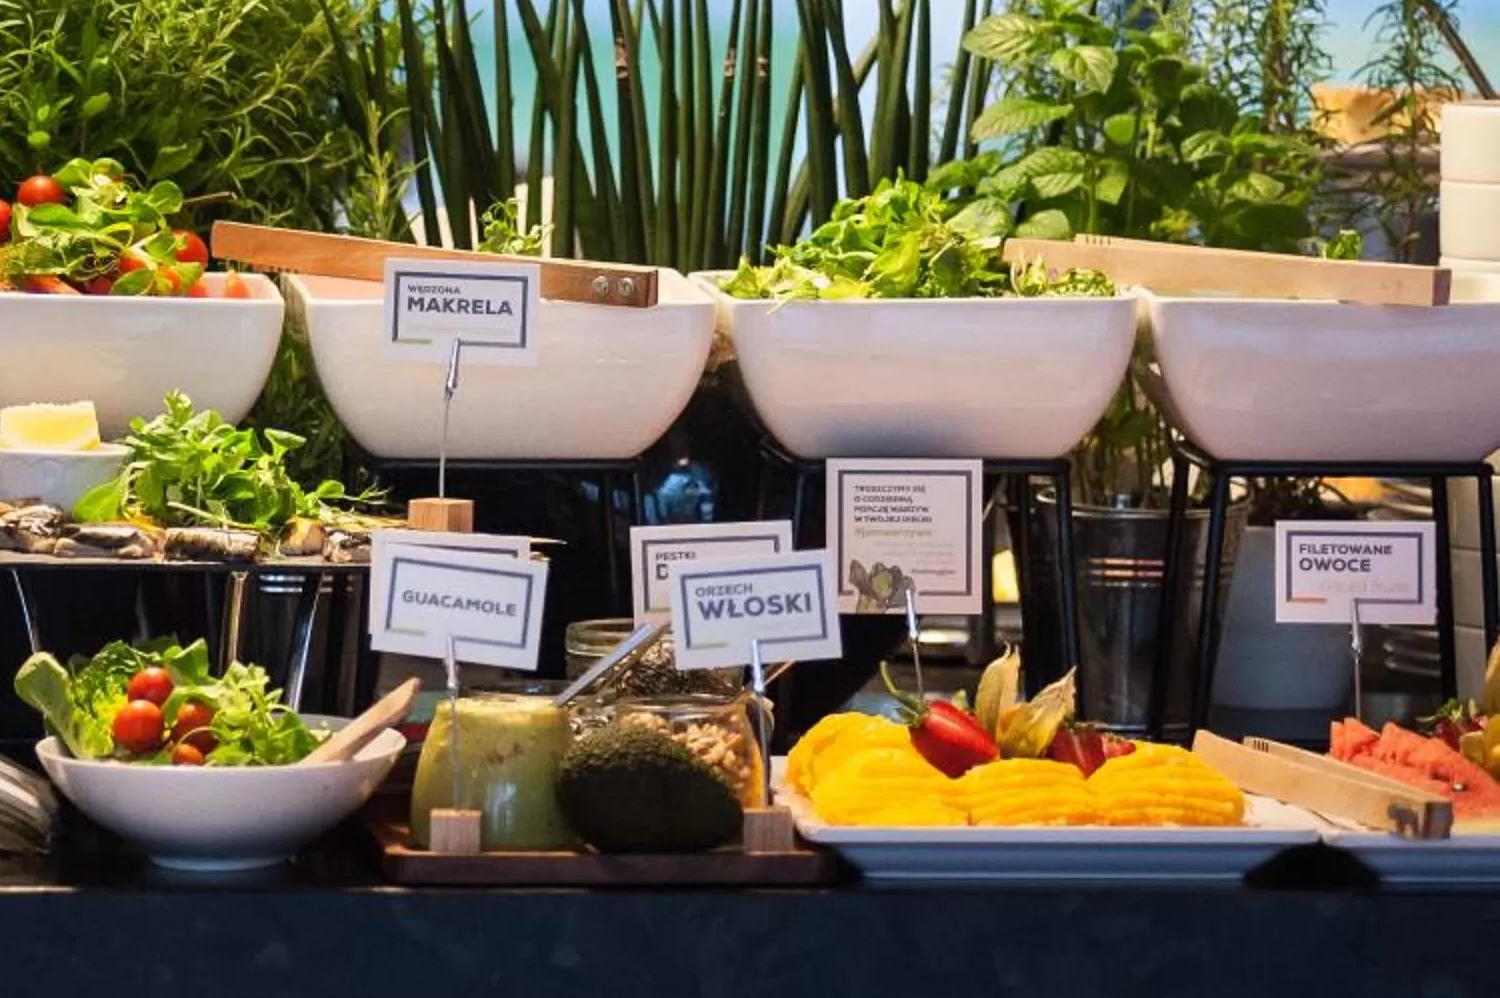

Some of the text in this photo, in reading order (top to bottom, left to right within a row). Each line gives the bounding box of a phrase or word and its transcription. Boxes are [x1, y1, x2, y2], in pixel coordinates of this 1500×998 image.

[407, 296, 514, 316] MAKRELA
[655, 551, 696, 561] PESTKI
[1299, 543, 1393, 555] FILETOWANE
[1299, 558, 1371, 572] OWOCE
[695, 583, 753, 598] ORZECH
[402, 589, 517, 617] GUACAMOLE
[697, 593, 812, 620] WŁOSKI
